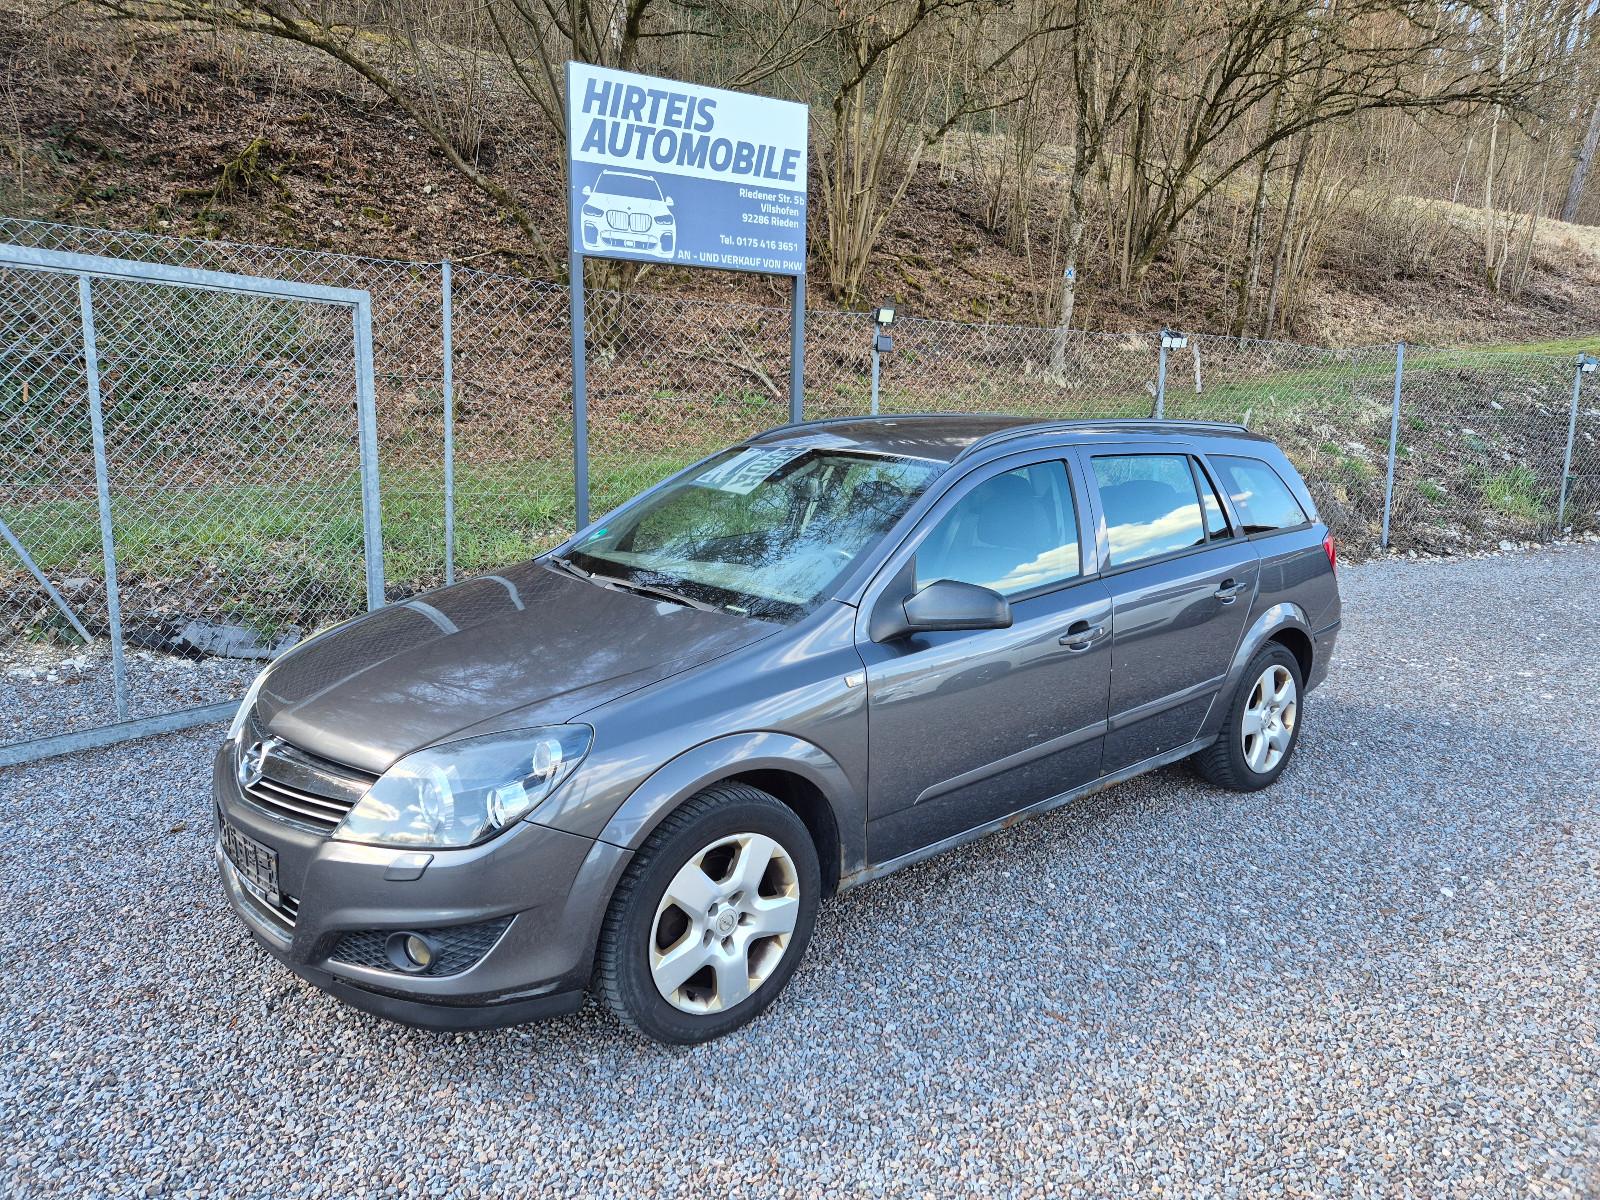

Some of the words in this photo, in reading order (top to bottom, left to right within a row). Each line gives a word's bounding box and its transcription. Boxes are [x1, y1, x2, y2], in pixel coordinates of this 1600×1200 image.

[582, 77, 717, 133] HIRTEIS
[580, 117, 802, 182] AUTOMOBILE
[739, 188, 777, 202] Riedener
[778, 193, 792, 204] Str.
[794, 195, 805, 206] 5b
[760, 203, 799, 217] Vilshofen
[742, 213, 769, 225] 92286
[771, 216, 799, 229] Rieden
[719, 234, 734, 245] Tel.
[736, 236, 758, 248] 0175
[760, 240, 776, 250] 416
[777, 241, 798, 252] 3651
[677, 250, 691, 260] AN
[699, 252, 720, 263] UND
[721, 254, 761, 267] VERKAUF
[762, 258, 781, 269] VON
[783, 261, 803, 271] PKW
